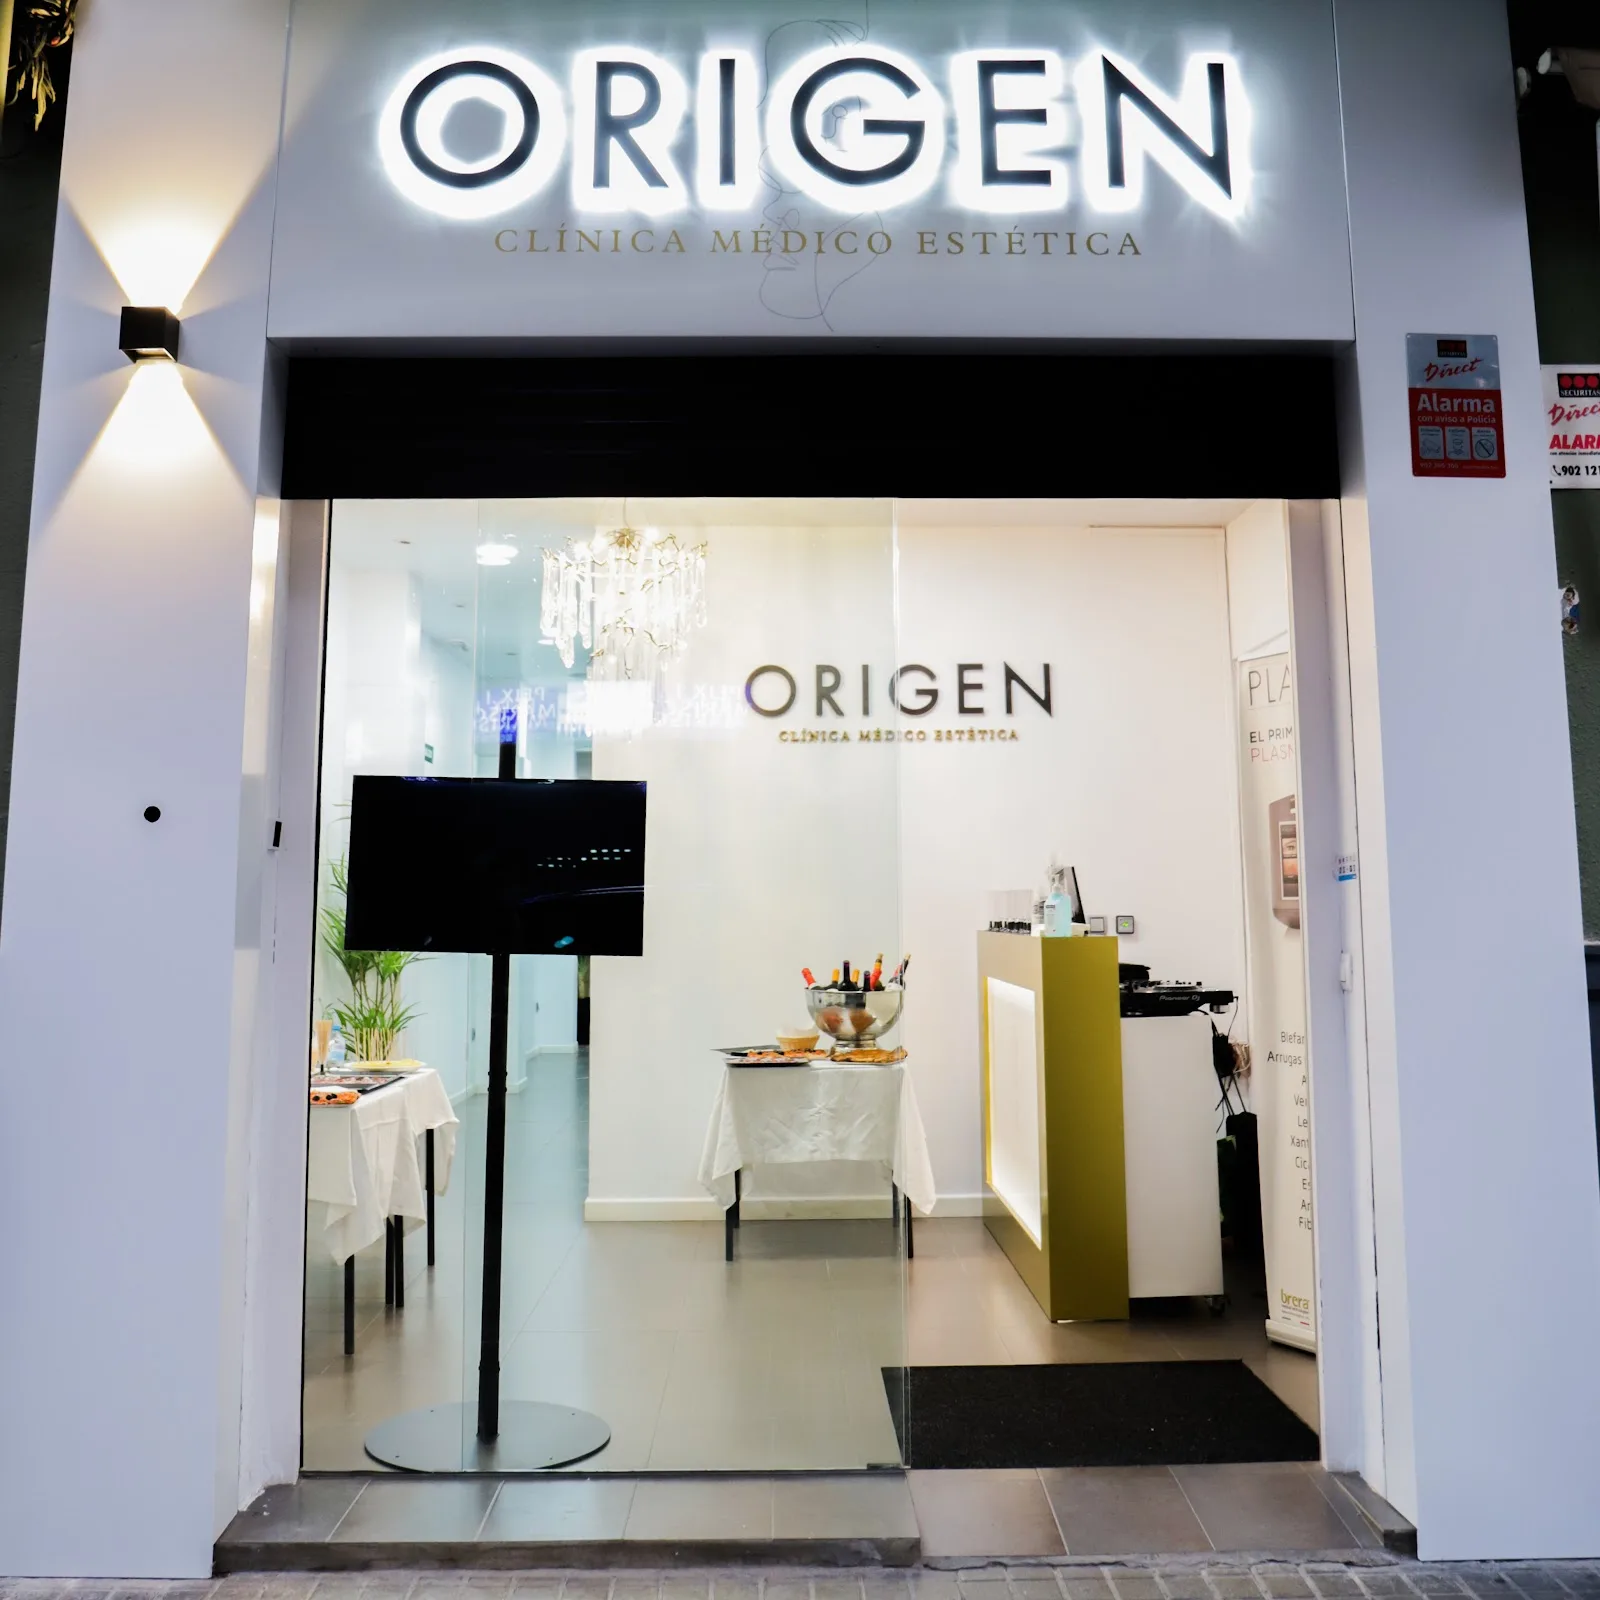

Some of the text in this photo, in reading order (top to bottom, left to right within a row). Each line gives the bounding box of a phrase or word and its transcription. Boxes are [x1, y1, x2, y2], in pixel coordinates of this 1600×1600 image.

[400, 54, 1233, 199] ORIGEN
[494, 223, 1142, 257] CLÍNICA MÉDICO ESTÉTICA
[1424, 358, 1482, 382] Direct
[1417, 393, 1495, 413] Alarma
[1560, 389, 1600, 397] SECURITAS
[1548, 402, 1600, 426] Direc
[1561, 465, 1581, 476] 902
[744, 661, 1054, 718] ORIGEN
[778, 726, 1019, 743] CLÍNICA MÉDICO ESTÉTICA
[1249, 731, 1264, 743] EL
[1267, 1050, 1302, 1066] Arrugas
[1281, 1288, 1310, 1310] brera
